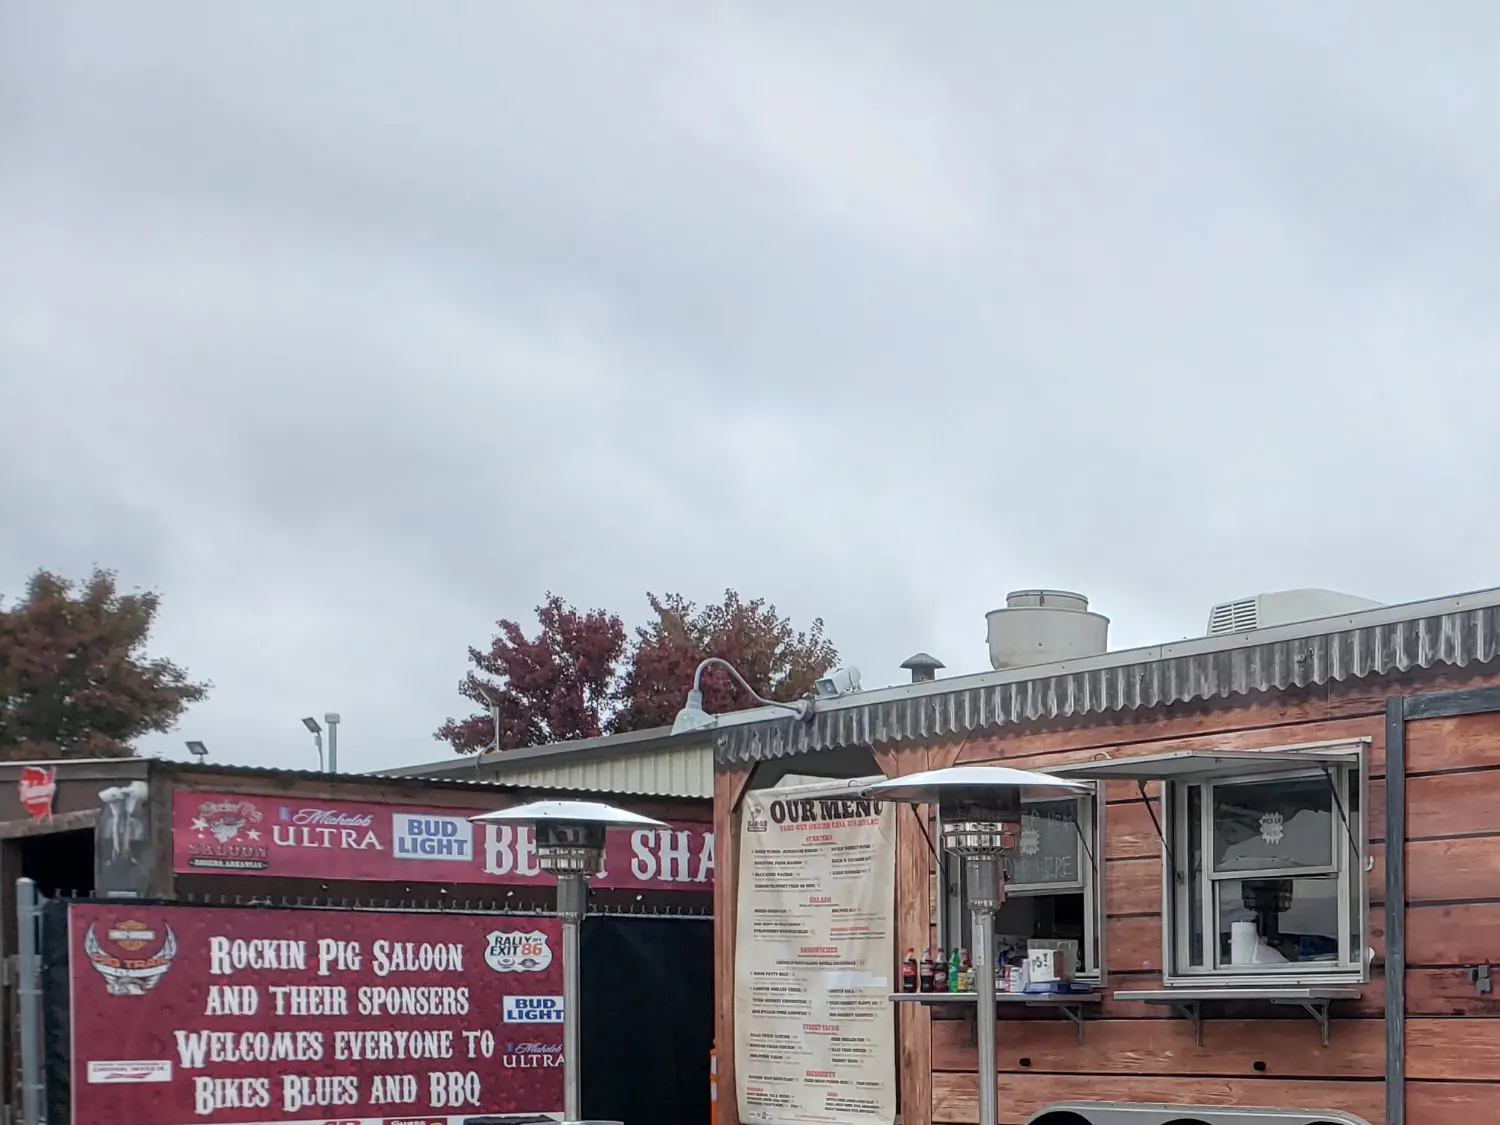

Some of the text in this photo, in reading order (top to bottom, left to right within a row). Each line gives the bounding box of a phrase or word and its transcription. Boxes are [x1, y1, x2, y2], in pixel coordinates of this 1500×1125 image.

[292, 808, 375, 827] Michelob
[770, 799, 884, 824] OUR MENU
[272, 825, 383, 849] ULTRA
[407, 819, 458, 837] BUD
[188, 842, 268, 858] SALOON
[398, 837, 468, 855] LIGHT
[490, 943, 543, 956] EXIT 86
[494, 936, 532, 946] RALLY
[204, 985, 469, 1016] AND THEIR SPONSERS
[515, 998, 556, 1009] BUD
[507, 1010, 564, 1020] LIGHT
[334, 1030, 453, 1060] EVERYONE
[462, 1028, 495, 1058] TO
[515, 1042, 562, 1053] Michelob
[503, 1054, 564, 1068] ULTRA
[369, 1073, 418, 1104] AND
[428, 1071, 481, 1108] BBQ
